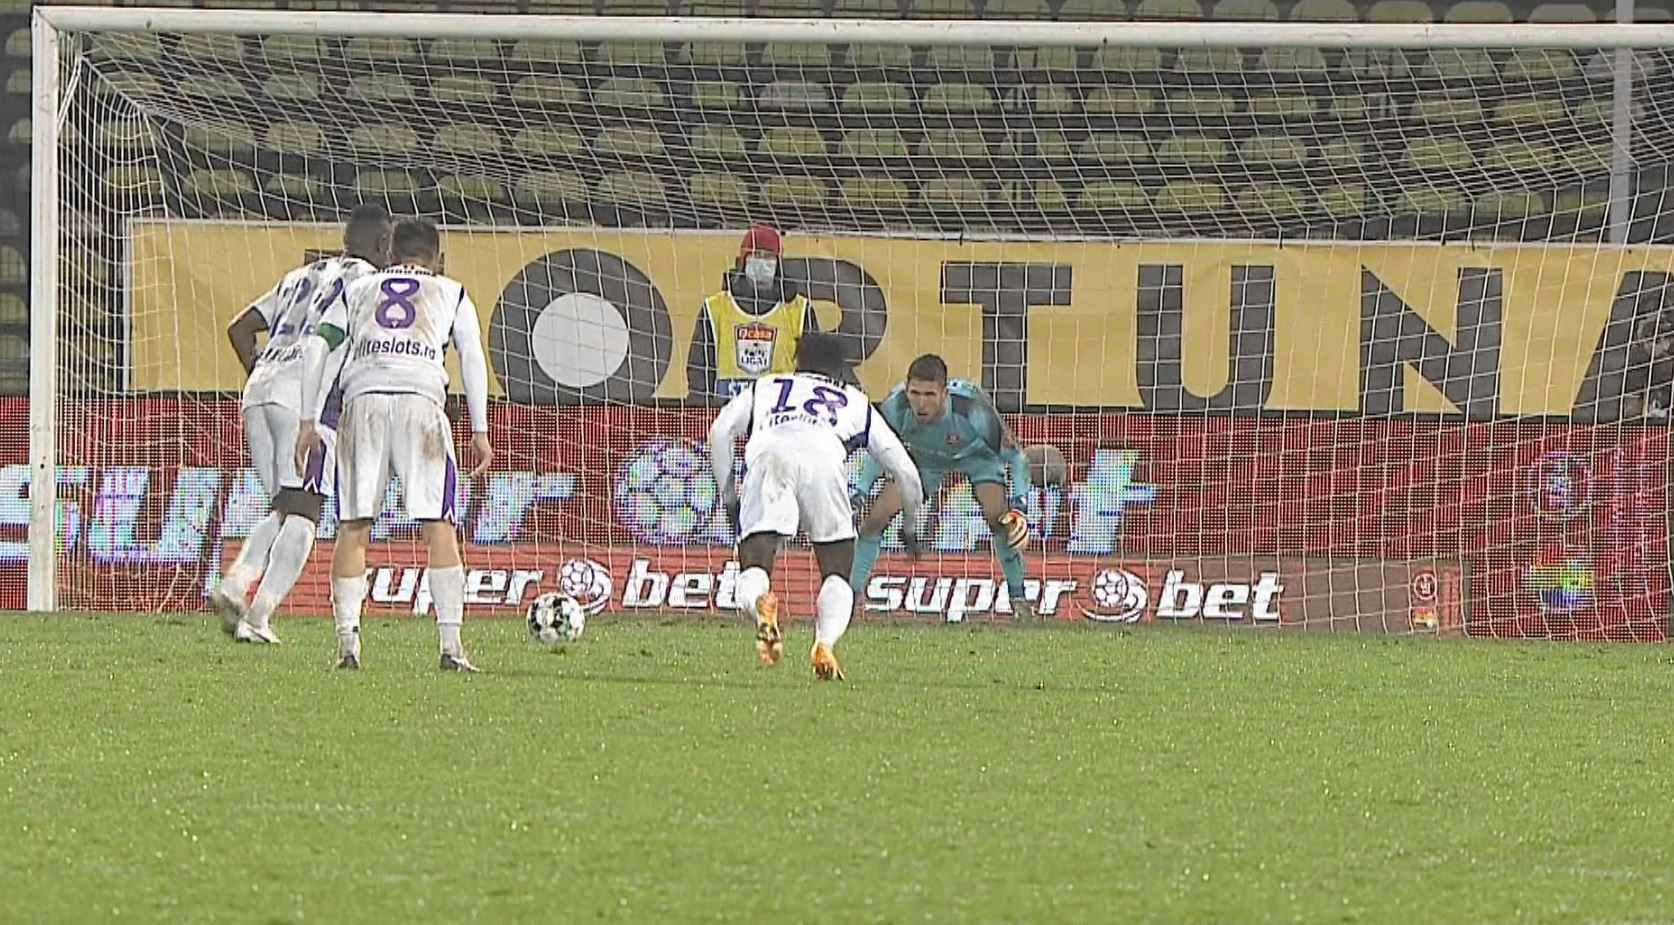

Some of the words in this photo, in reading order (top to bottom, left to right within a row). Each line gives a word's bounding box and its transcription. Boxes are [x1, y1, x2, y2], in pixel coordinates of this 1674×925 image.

[375, 278, 420, 329] 8
[304, 247, 1674, 421] ORTUNA
[771, 378, 848, 427] 18
[622, 558, 742, 609] bet
[1156, 570, 1286, 619] bet
